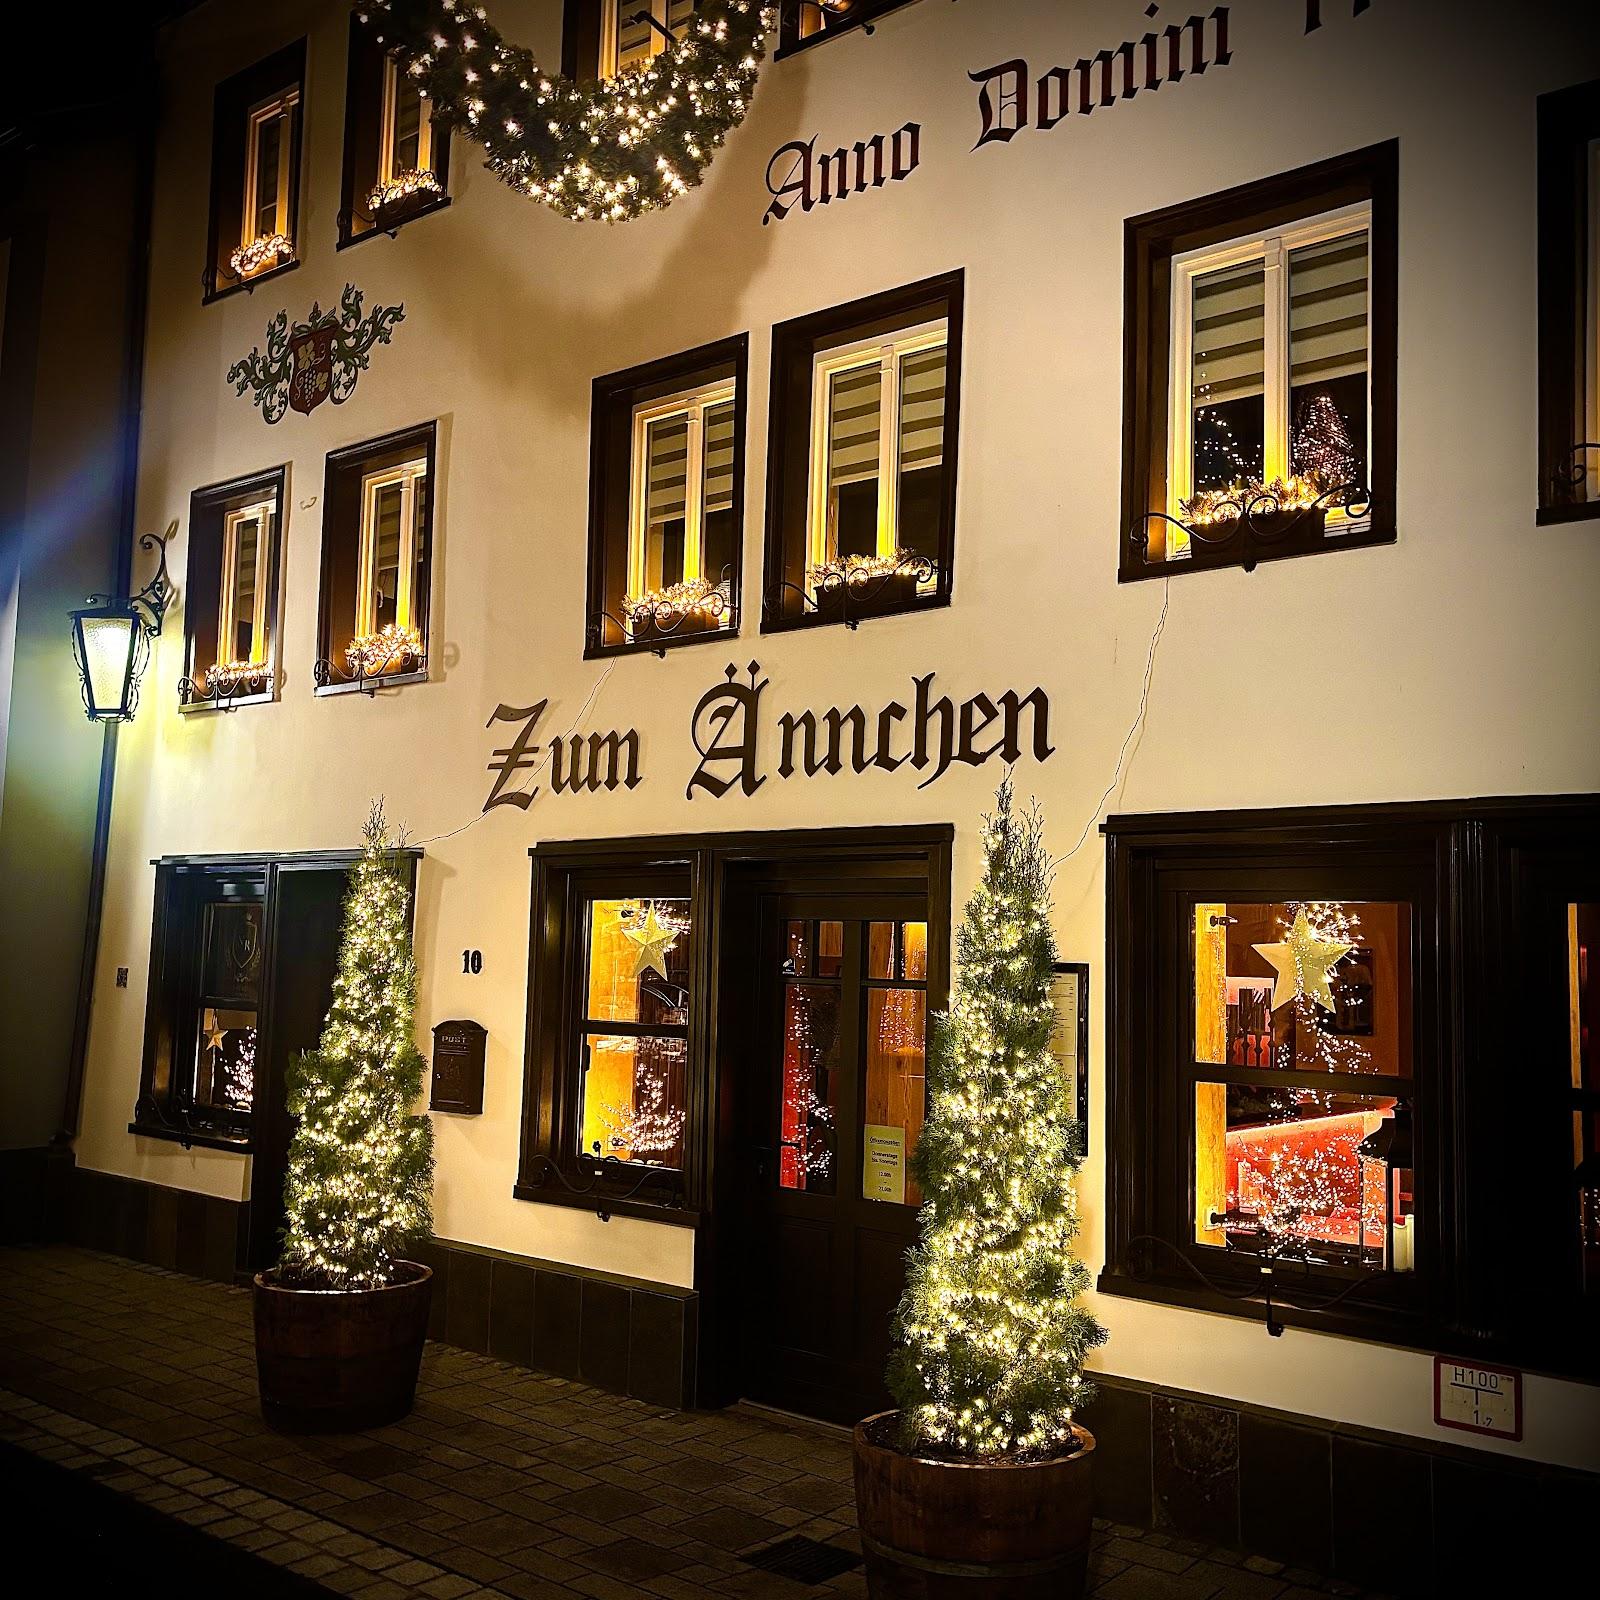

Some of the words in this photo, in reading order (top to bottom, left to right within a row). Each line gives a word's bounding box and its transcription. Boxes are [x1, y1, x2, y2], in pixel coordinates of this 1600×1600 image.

[763, 121, 922, 225] Anno
[968, 2, 1233, 152] Domini
[482, 698, 642, 813] Zum
[686, 659, 1056, 801] Ännchen
[462, 949, 483, 974] 10
[1454, 1367, 1498, 1388] H100
